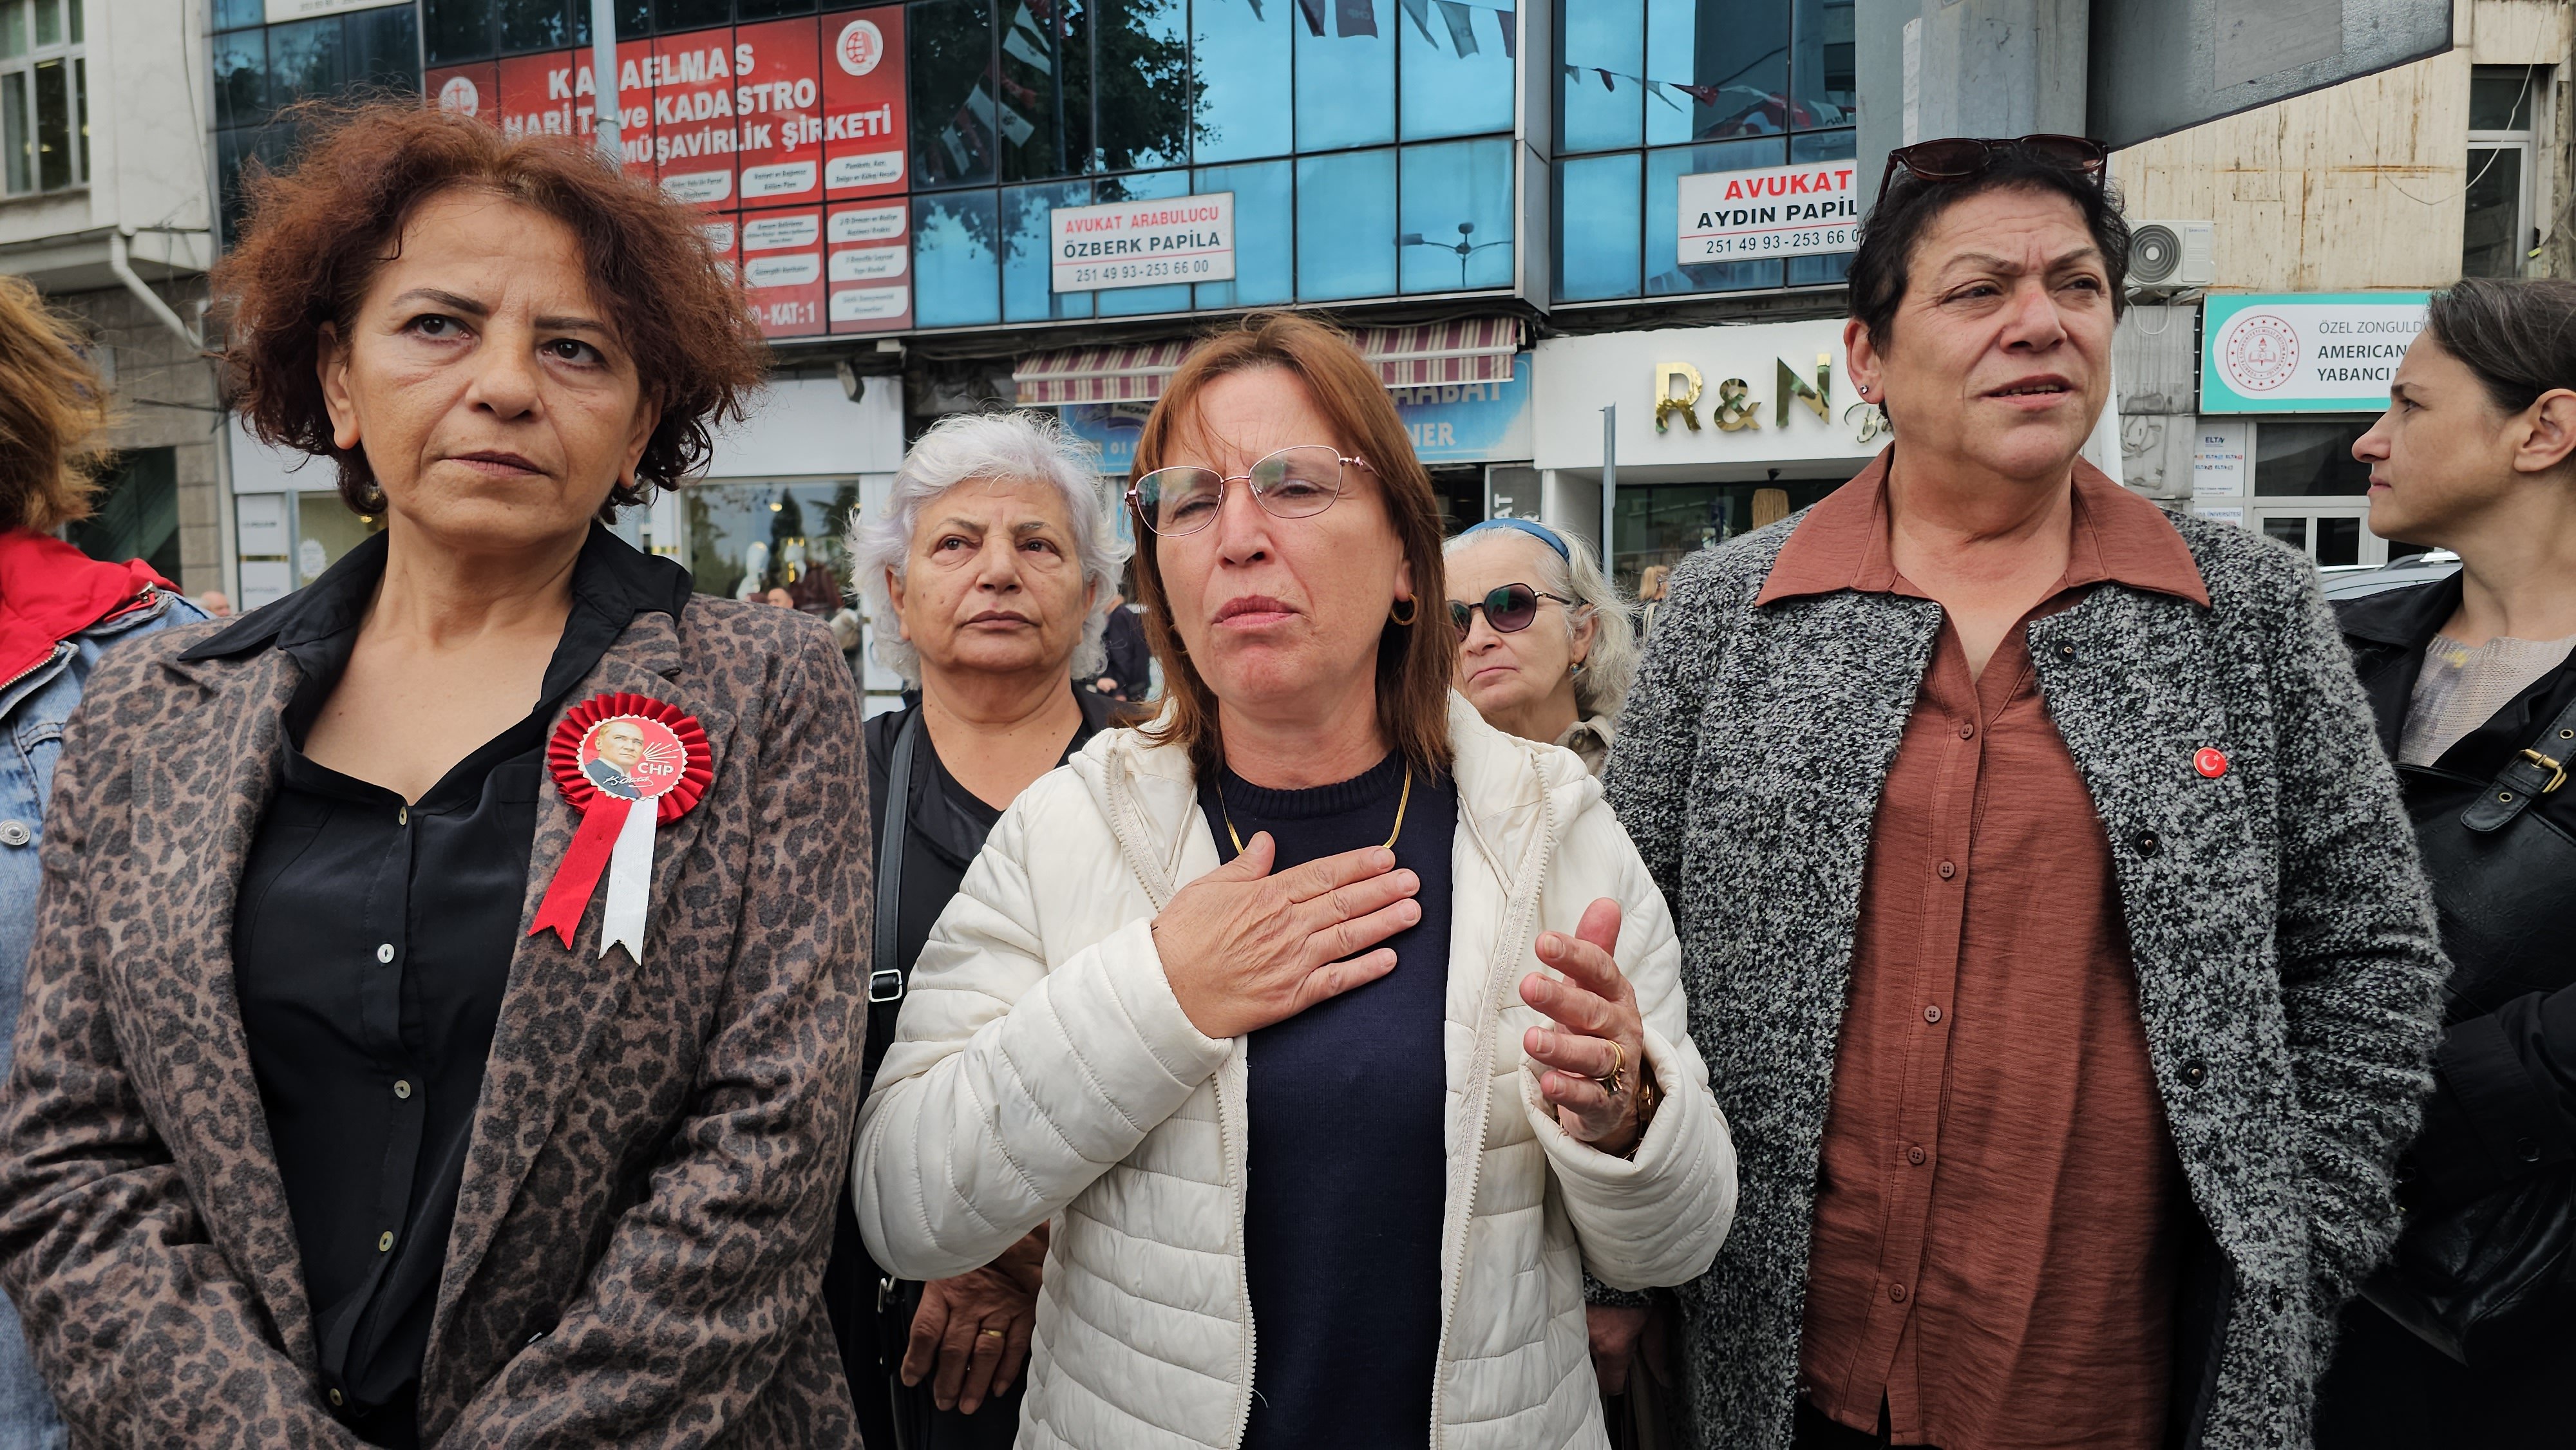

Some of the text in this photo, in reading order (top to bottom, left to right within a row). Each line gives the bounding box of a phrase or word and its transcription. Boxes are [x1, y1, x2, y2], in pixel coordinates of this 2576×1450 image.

[549, 43, 755, 100] KAAELMAS
[504, 77, 816, 140] HARİT ve KADASTRO
[620, 103, 891, 166] MÜŞAVİRLİK ŞİRKETİ
[1724, 169, 1853, 200] AVUKAT
[1065, 206, 1218, 234] AVUKAT ARABULUCU
[1697, 206, 1776, 229] AYDIN
[1064, 229, 1220, 258] ÖZBERK PAPİLA
[1707, 239, 1731, 254] 251
[1739, 237, 1756, 251] 49
[1827, 230, 1844, 244] 66
[1076, 268, 1097, 282] 251
[1103, 267, 1117, 279] 49
[1174, 261, 1189, 274] 66
[1194, 259, 1209, 272] 00
[2319, 320, 2423, 334] ÖZEL ZONGULD
[2318, 344, 2407, 359] AMERICAN
[2318, 368, 2389, 381] YABANCI
[638, 762, 674, 777] CHP
